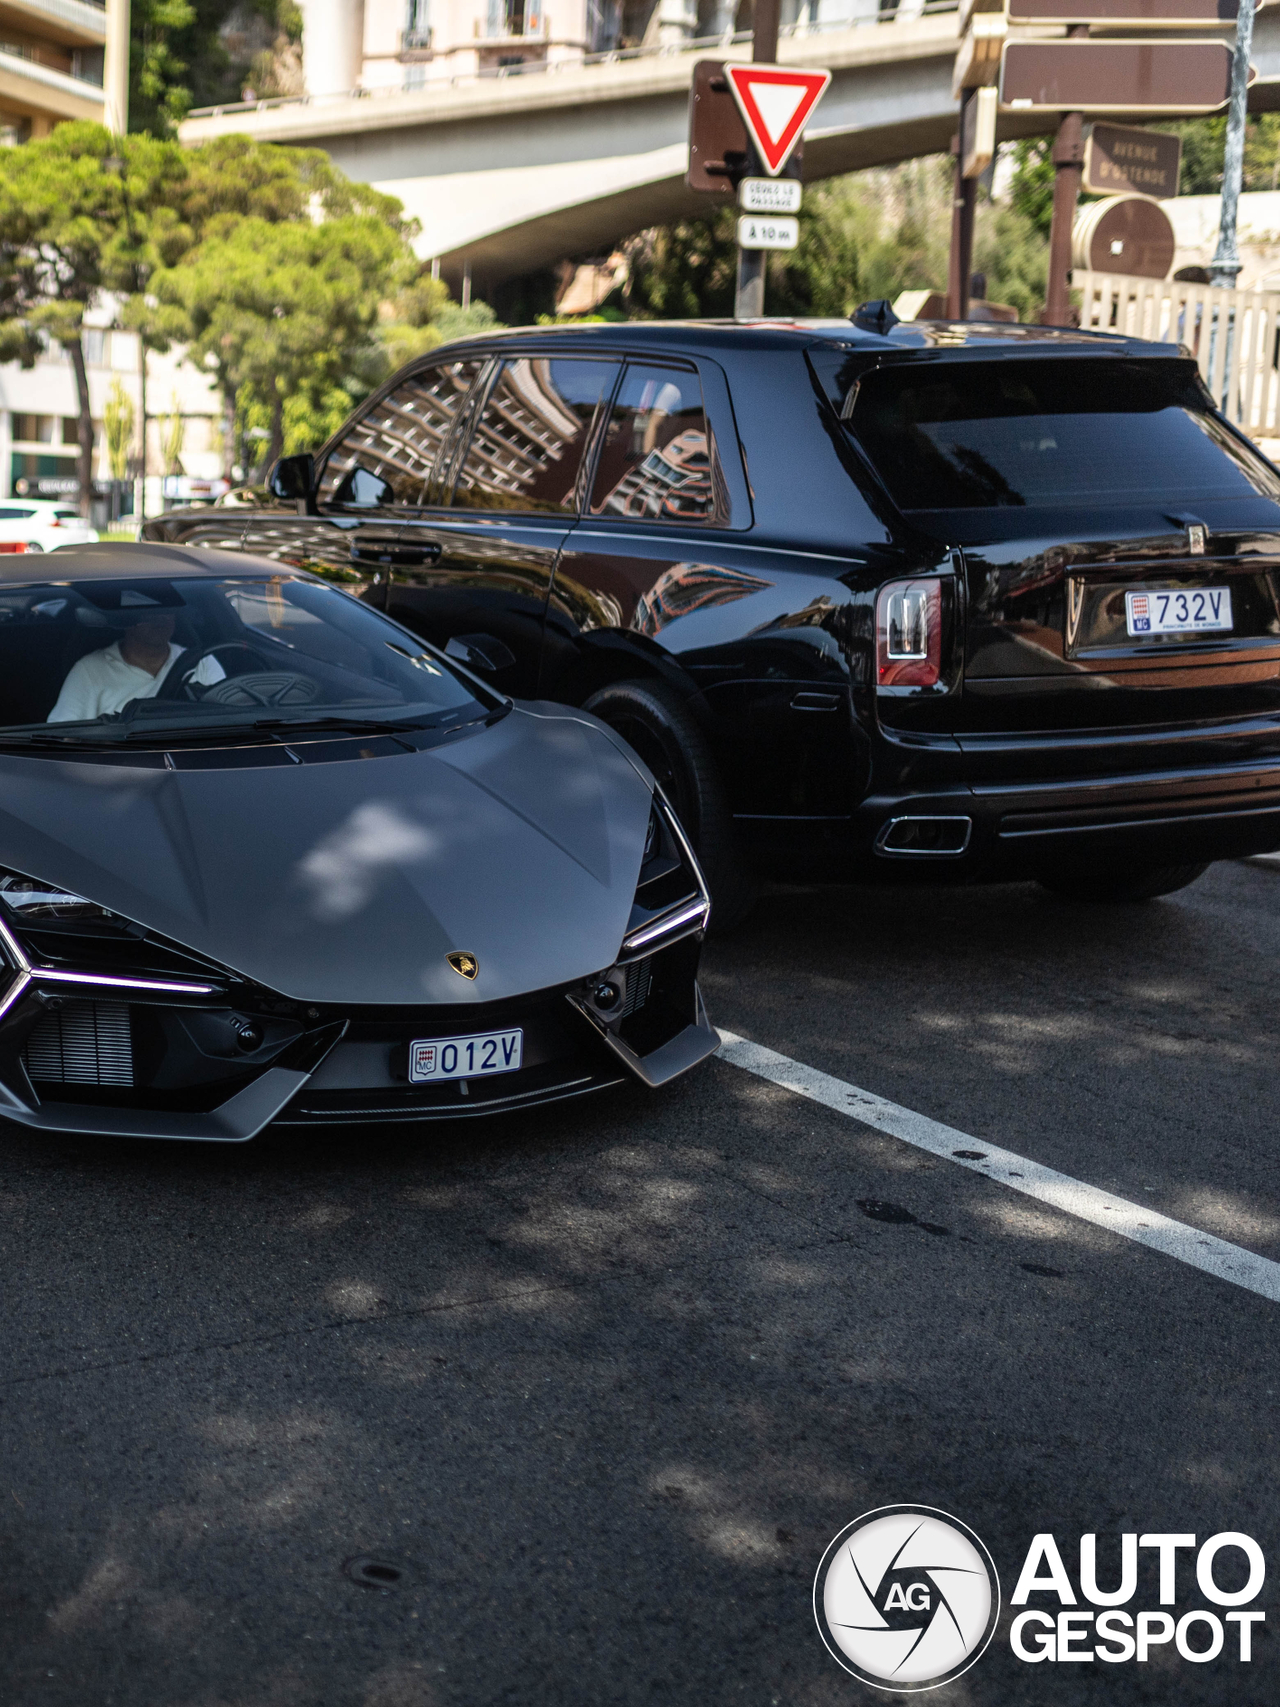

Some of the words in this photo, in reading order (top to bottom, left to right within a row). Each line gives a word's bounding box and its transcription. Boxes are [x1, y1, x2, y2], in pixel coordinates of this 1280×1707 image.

[1113, 142, 1158, 162] AVENUE
[1099, 161, 1166, 186] D'OSTENDE
[783, 184, 795, 196] LE
[761, 226, 776, 240] 10
[778, 230, 790, 241] m
[1156, 591, 1222, 624] 732V
[1136, 619, 1148, 630] MC
[441, 1036, 516, 1073] 012V
[418, 1061, 432, 1071] MC
